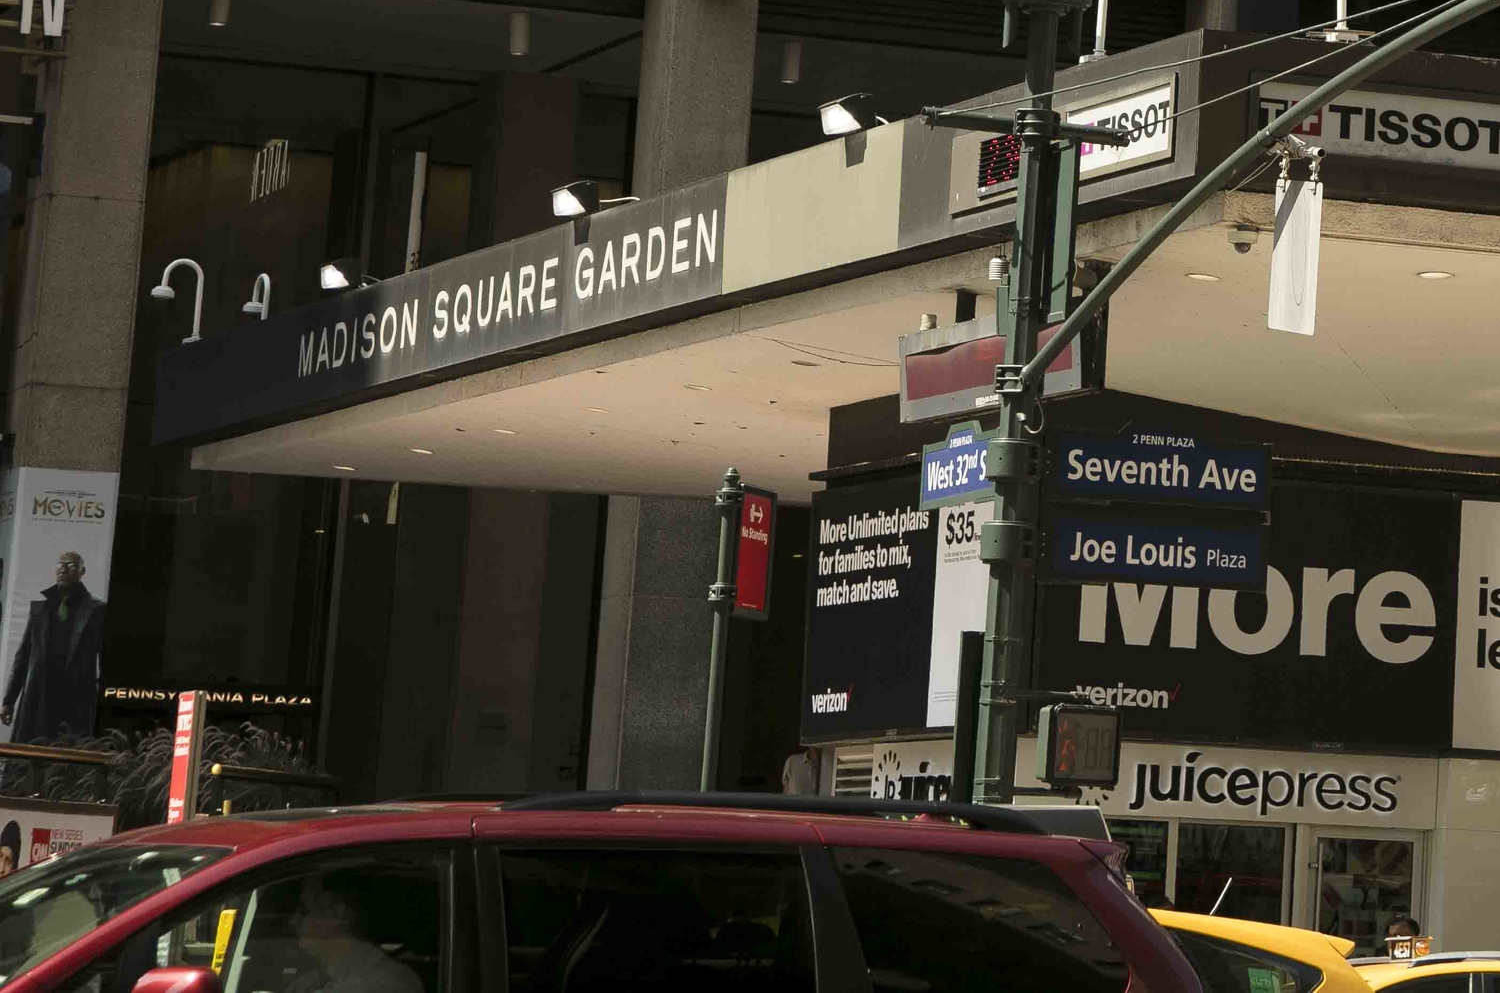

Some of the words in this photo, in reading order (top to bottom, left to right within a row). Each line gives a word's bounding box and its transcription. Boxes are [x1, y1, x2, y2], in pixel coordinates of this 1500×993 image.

[298, 298, 419, 377] MADISON
[432, 256, 559, 339] SQUARE
[574, 209, 718, 299] GARDEN
[1132, 434, 1138, 444] 2
[1141, 434, 1165, 447] PENN
[1166, 436, 1195, 448] PLAZA
[927, 459, 955, 492] West
[955, 449, 979, 486] 32nd
[979, 449, 987, 481] S
[1067, 449, 1189, 488] Seventh
[1198, 459, 1257, 493] Ave
[32, 496, 105, 519] MOVIES
[820, 519, 847, 544] More
[848, 508, 898, 540] Unlimited
[899, 506, 930, 539] plans
[742, 526, 748, 538] No
[749, 527, 768, 545] Standing
[945, 510, 975, 549] $35
[818, 550, 834, 575] for
[835, 543, 876, 574] families
[876, 550, 889, 571] to
[889, 540, 912, 569] mix,
[1070, 532, 1117, 564] Joe
[1125, 535, 1197, 569] Louis
[1206, 549, 1247, 569] Plaza
[817, 579, 849, 607] match
[850, 575, 871, 603] and
[871, 578, 899, 601] save.
[1078, 564, 1437, 664] More
[104, 687, 243, 704] PENNSYANIA
[251, 693, 312, 705] PLAZA
[811, 688, 847, 714] verizon
[1076, 682, 1169, 709] verizon
[1129, 751, 1399, 815] juicepress
